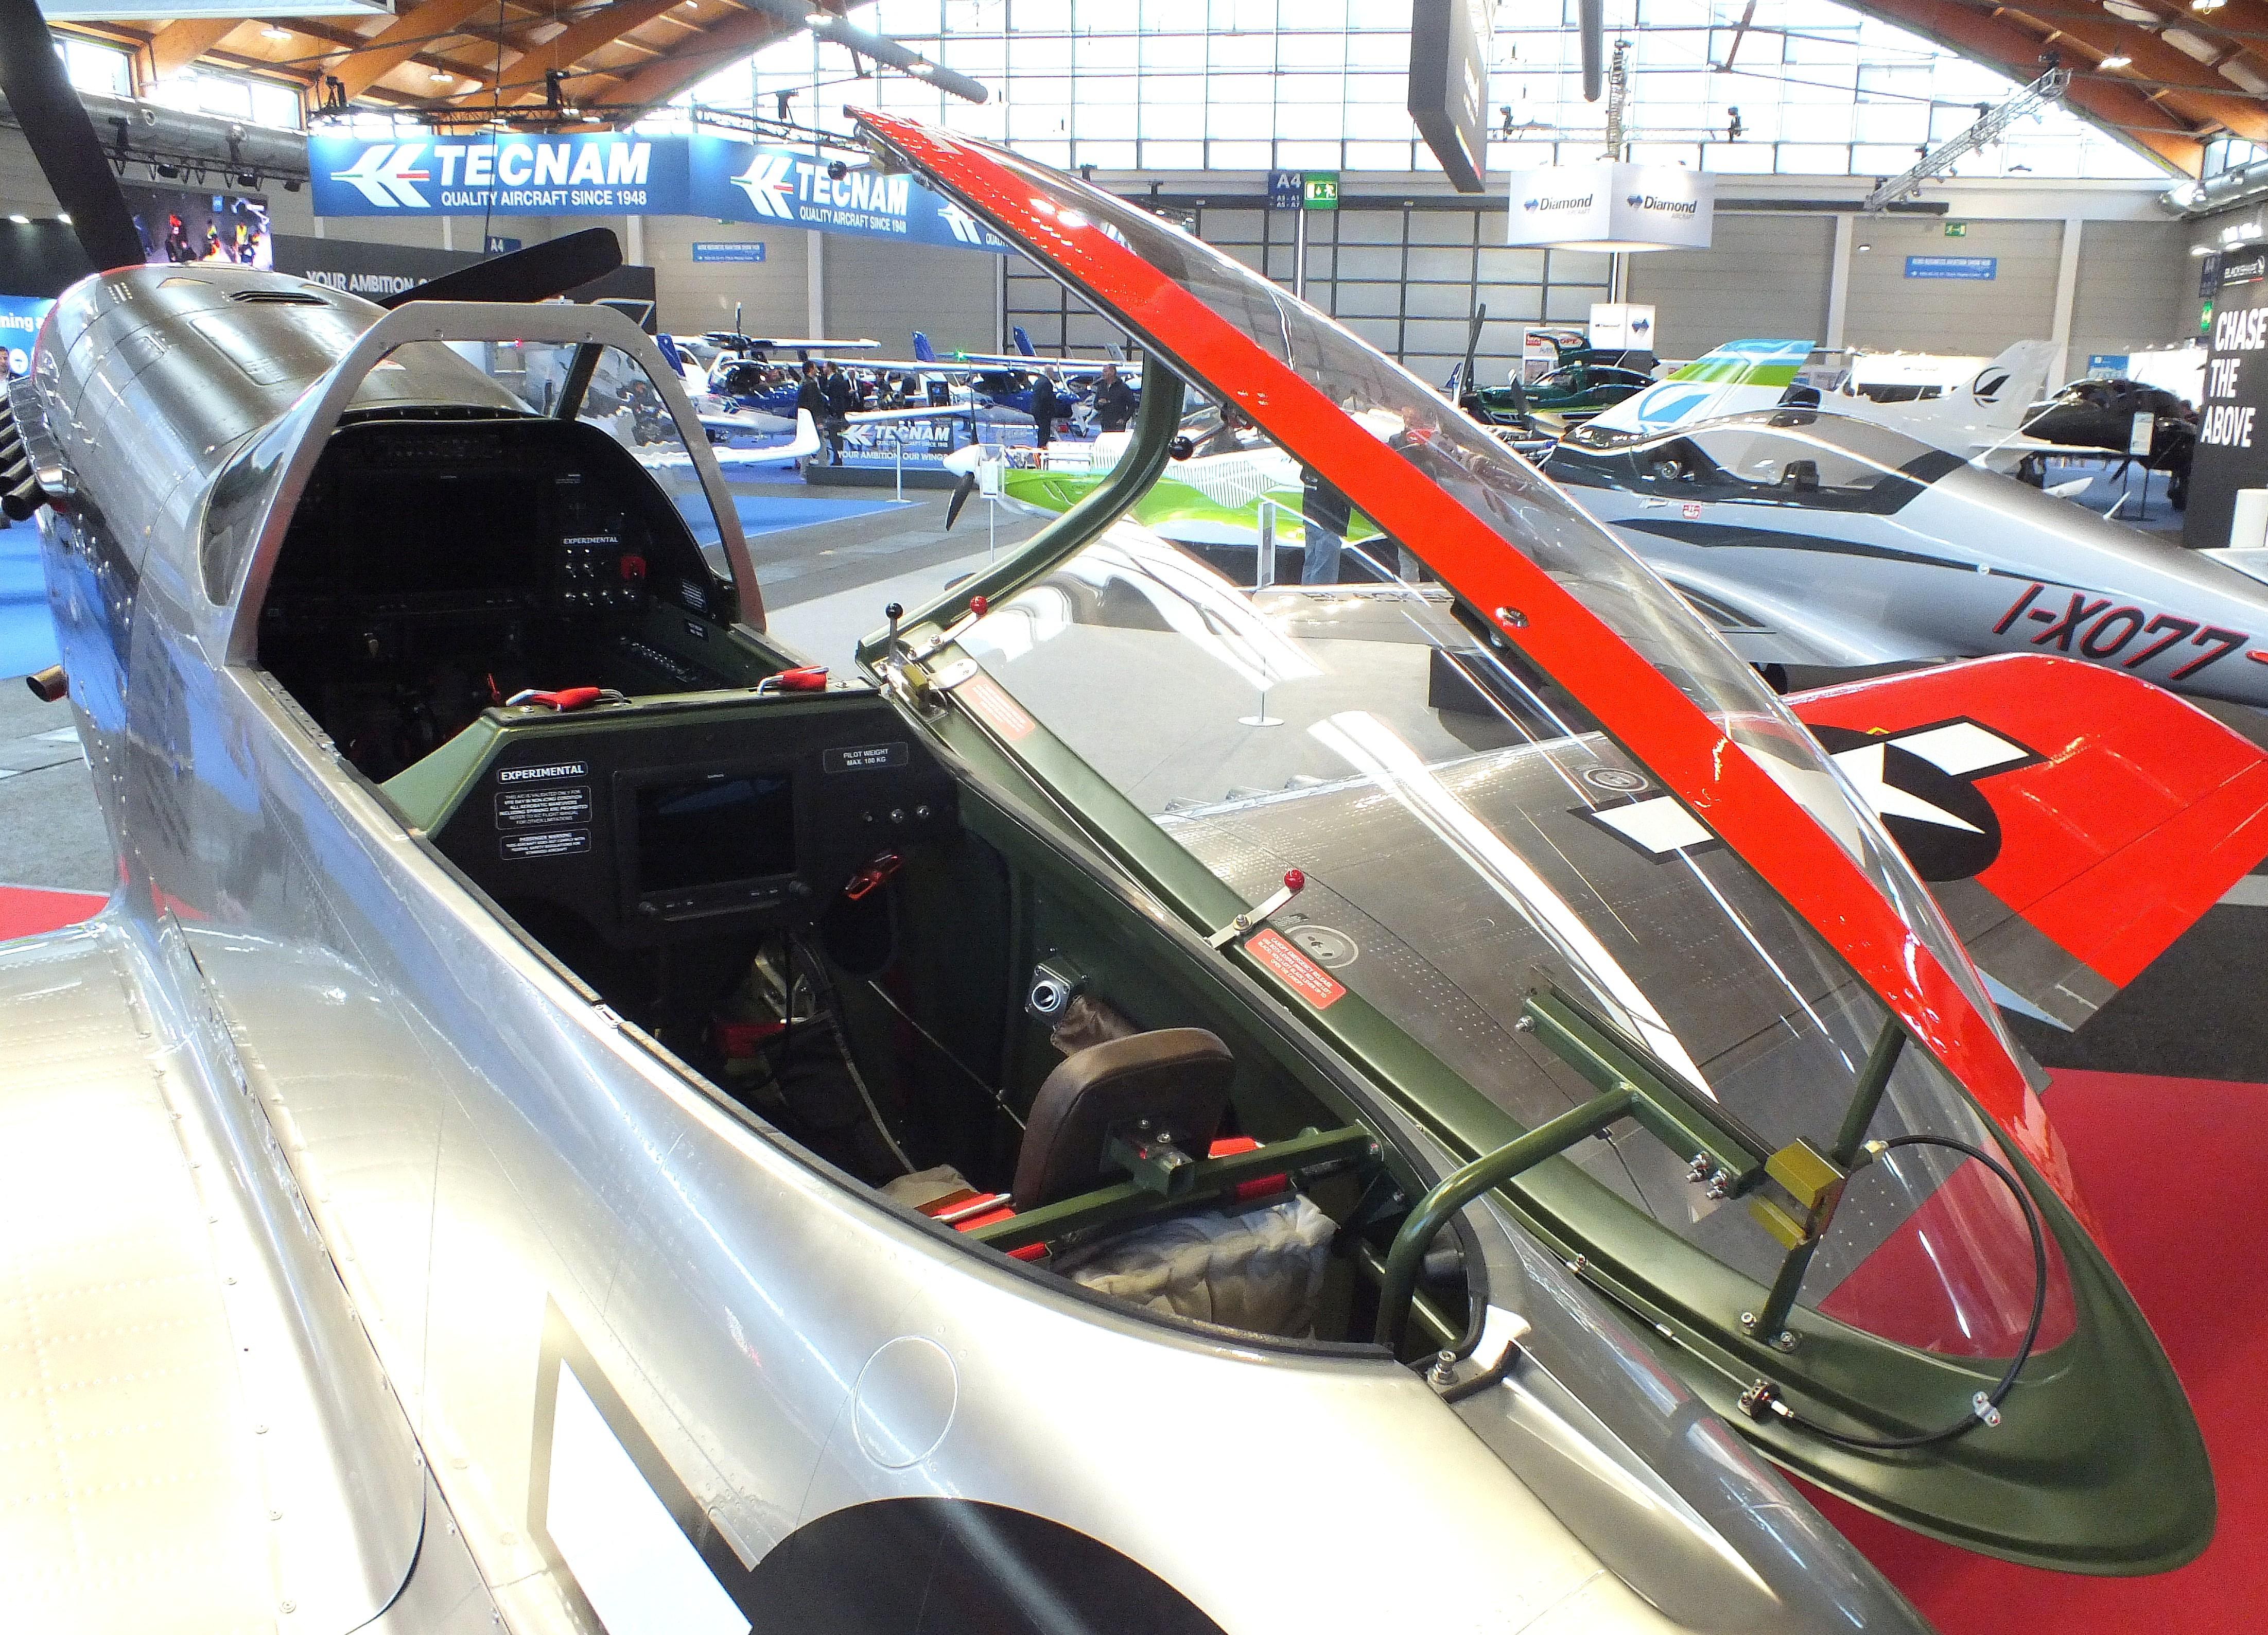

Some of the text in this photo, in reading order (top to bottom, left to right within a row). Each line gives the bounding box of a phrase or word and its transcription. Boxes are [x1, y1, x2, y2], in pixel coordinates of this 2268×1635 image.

[434, 142, 652, 186] TECNAM
[795, 161, 909, 216] TECNAM
[1277, 173, 1301, 188] A4
[441, 190, 648, 206] QUALITY AIRCRAFT SINCE 1948
[1539, 194, 1593, 211] Diamond
[1644, 196, 1698, 214] Diamond
[799, 206, 907, 234] QUALITY AIRCRAFT SINCE 1948
[306, 270, 414, 293] YOUR AMBITION
[2215, 307, 2268, 352] CHASE
[2209, 358, 2241, 398] THE
[875, 425, 950, 442] TECNAM
[2200, 405, 2256, 448] ABOVE
[836, 450, 859, 459] YOUR
[563, 536, 618, 545] EXPERIMENTAL
[863, 749, 889, 757] WEIGHT
[501, 765, 584, 781] EXPERIMENTAL
